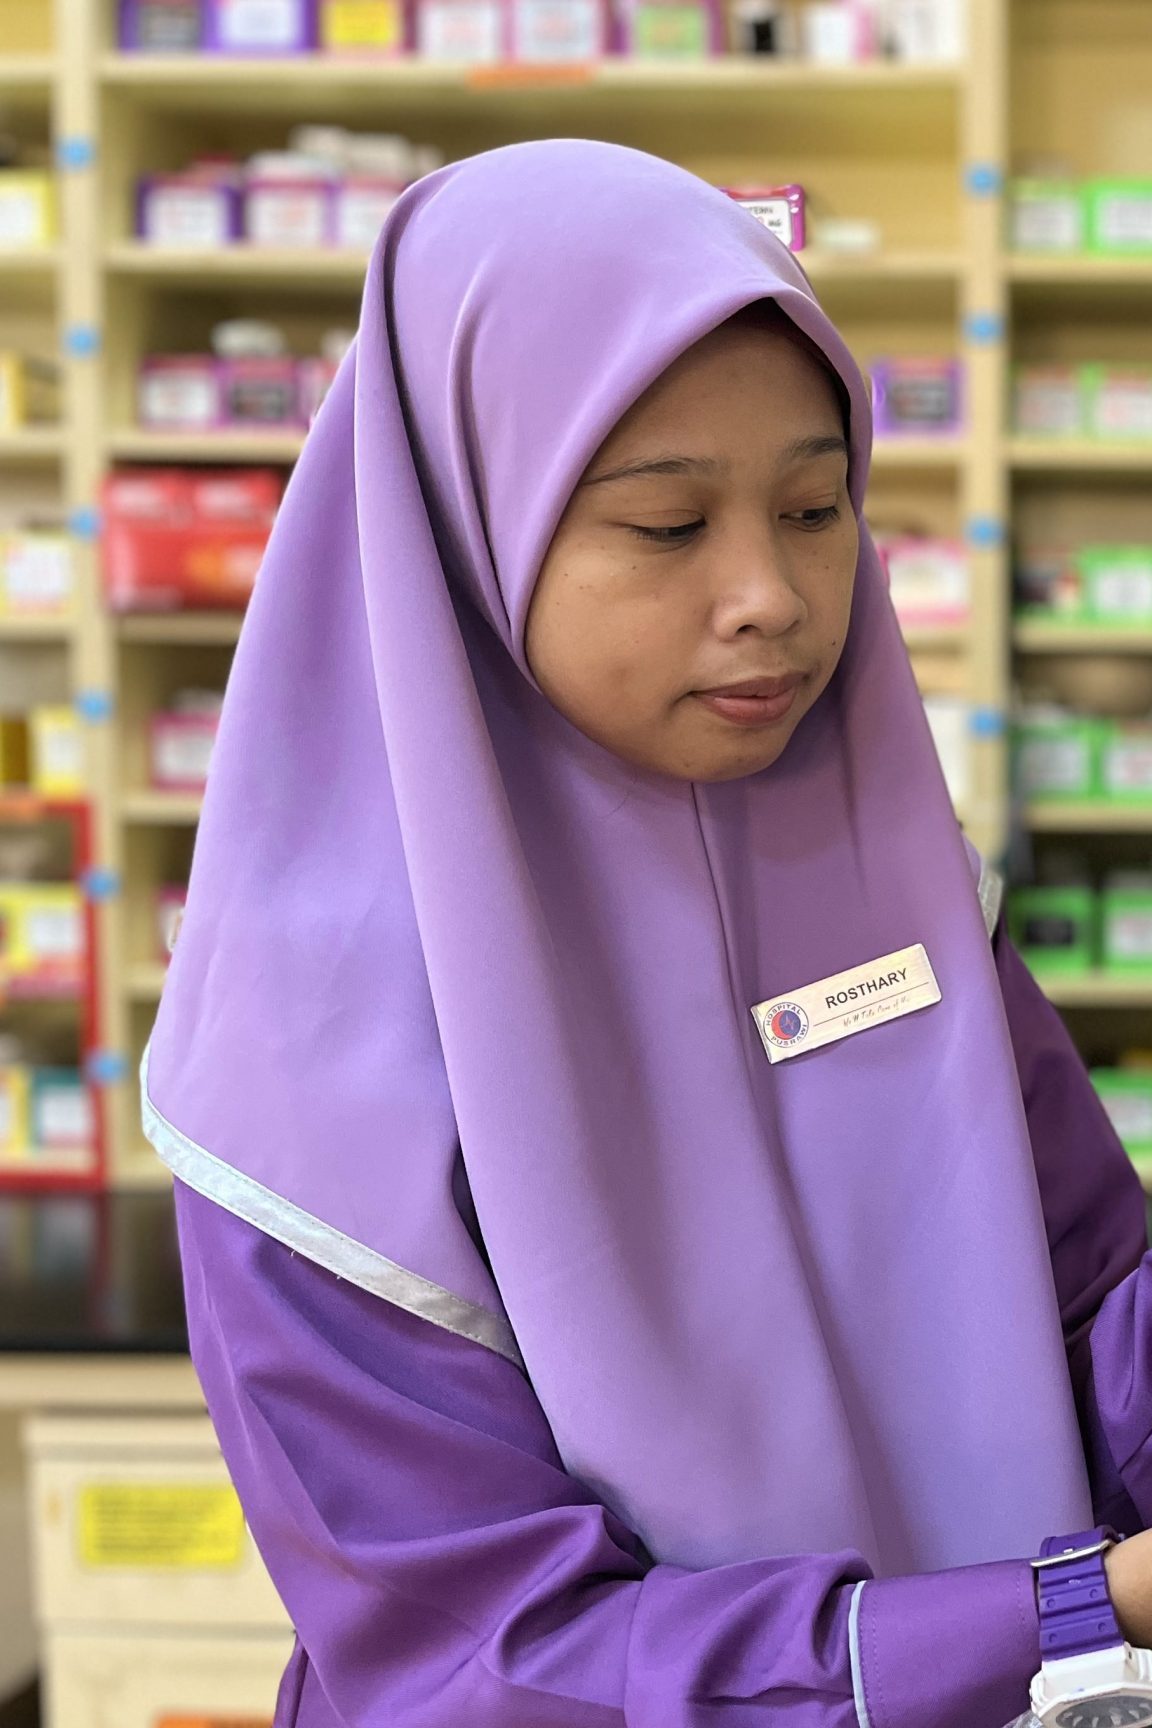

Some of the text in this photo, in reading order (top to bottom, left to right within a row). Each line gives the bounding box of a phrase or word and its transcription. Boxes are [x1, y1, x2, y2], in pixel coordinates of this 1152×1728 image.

[825, 967, 908, 1009] ROSTHARY
[766, 1003, 801, 1026] HOSPITAL
[771, 1024, 808, 1046] PUSRAWI
